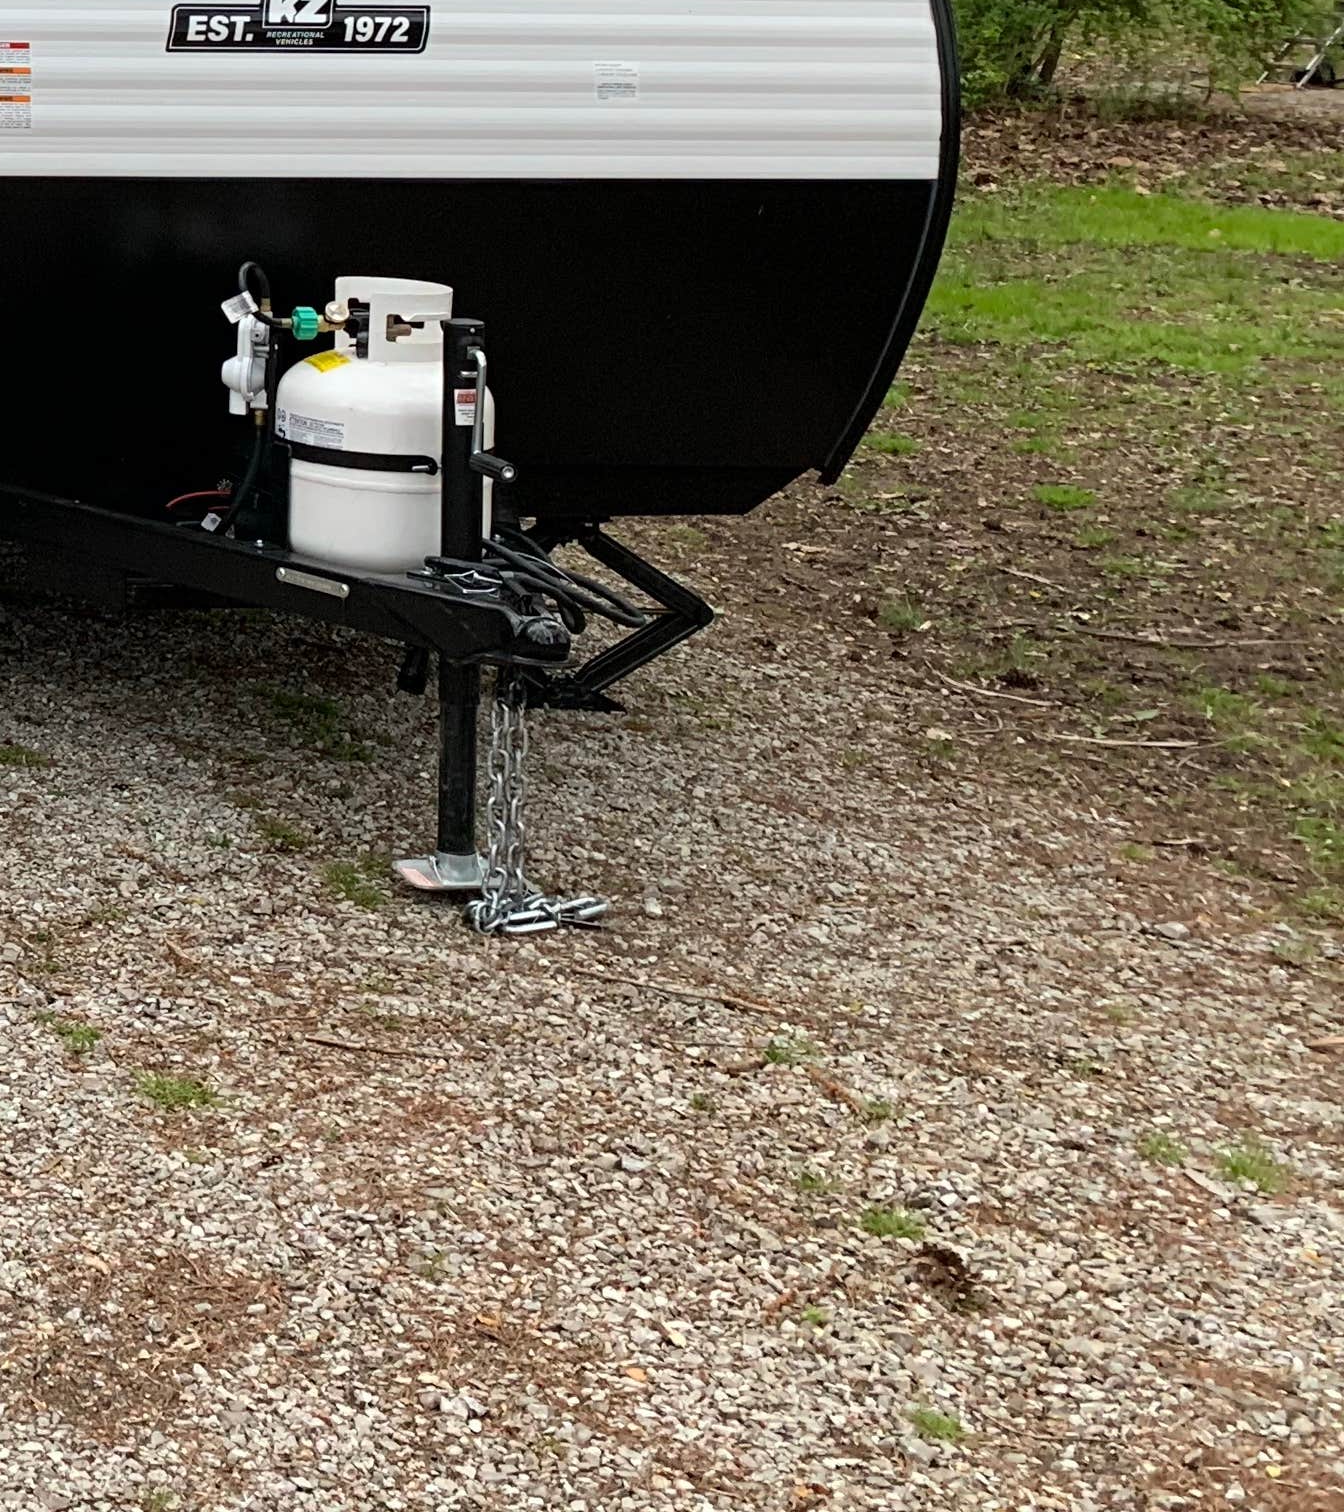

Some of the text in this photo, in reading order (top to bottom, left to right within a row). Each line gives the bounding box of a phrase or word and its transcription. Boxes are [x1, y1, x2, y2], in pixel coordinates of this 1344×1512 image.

[185, 14, 411, 43] EST. 1972
[265, 31, 325, 39] RECREATIONAL
[275, 38, 314, 46] VEHICLES
